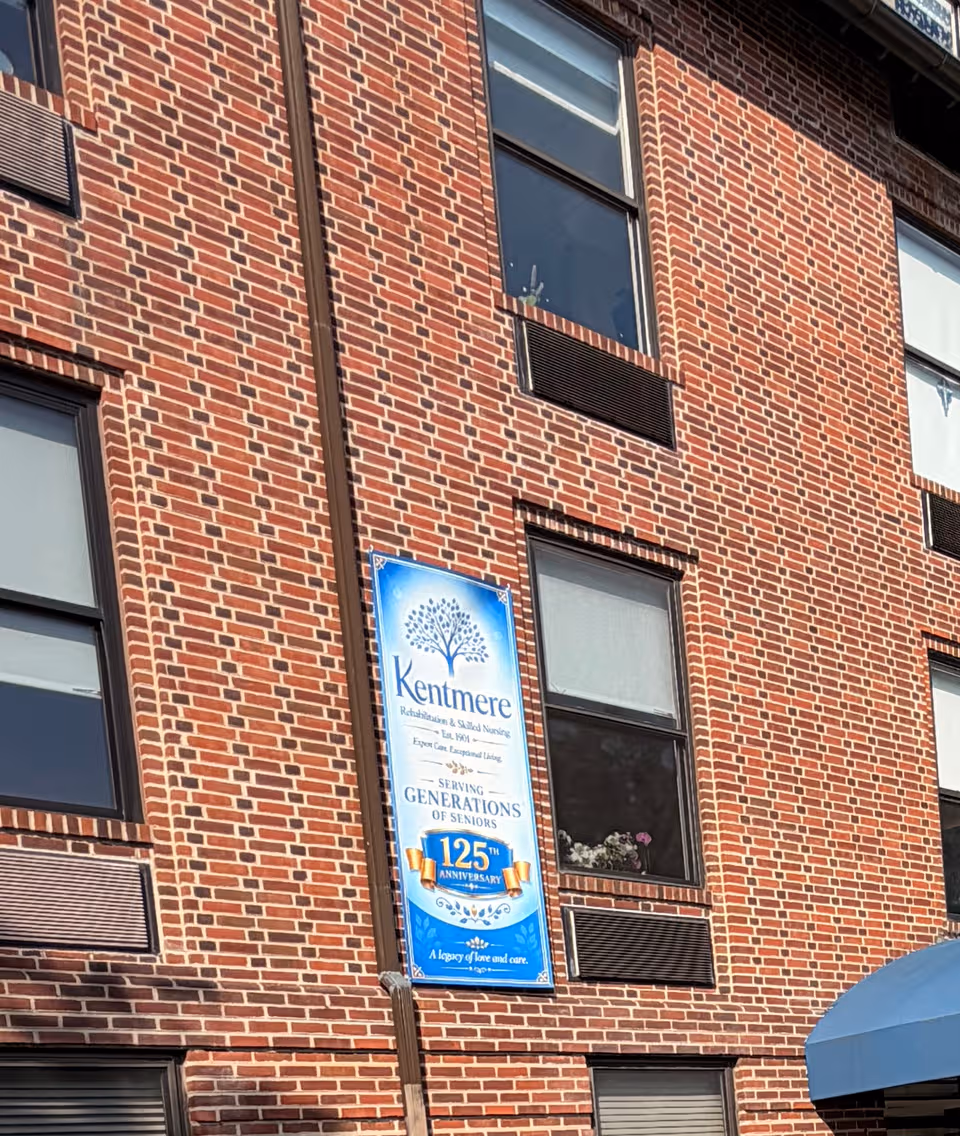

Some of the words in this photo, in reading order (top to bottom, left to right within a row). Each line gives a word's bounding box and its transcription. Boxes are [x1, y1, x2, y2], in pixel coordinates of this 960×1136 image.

[392, 655, 512, 719] Kentmere
[400, 705, 447, 726] Rehabilitation
[449, 717, 456, 727] &
[457, 719, 481, 733] Skilled
[482, 724, 511, 739] Nursing
[449, 745, 482, 759] Exceptional
[438, 778, 484, 796] SERVING
[404, 786, 521, 818] GENERATIONS
[432, 810, 446, 821] OF
[450, 812, 497, 829] SENIORS
[439, 870, 502, 885] ANNIVERSARY
[429, 949, 437, 960] A
[438, 949, 464, 964] legacy
[465, 950, 475, 964] of
[475, 951, 490, 962] love
[492, 953, 508, 964] and
[509, 955, 529, 965] care.
